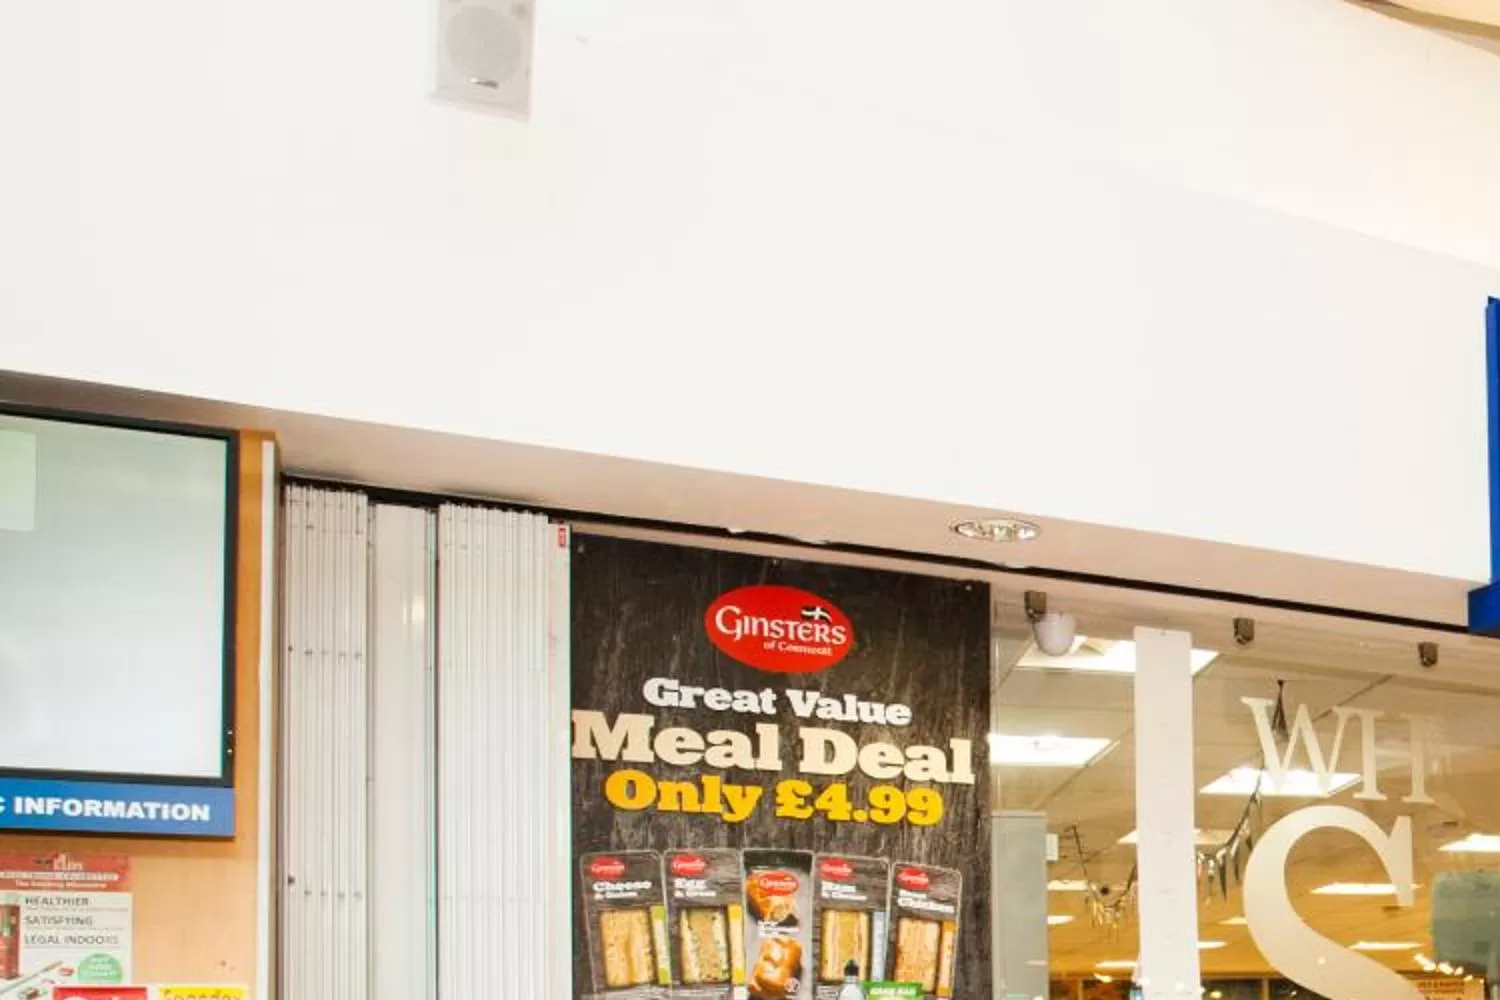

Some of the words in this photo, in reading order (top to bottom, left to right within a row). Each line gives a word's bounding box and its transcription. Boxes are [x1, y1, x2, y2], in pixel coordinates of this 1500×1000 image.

[763, 639, 777, 652] of
[642, 677, 778, 715] Great
[786, 688, 912, 726] Value
[572, 709, 783, 771] Meal
[799, 727, 975, 785] Deal
[1240, 696, 1435, 803] WH
[14, 796, 211, 821] INFORMATION
[605, 769, 762, 823] Only
[775, 779, 944, 826] £4.99
[25, 897, 89, 906] HEALTHIER
[24, 915, 94, 926] SATISFYING
[24, 935, 60, 945] LEGAL
